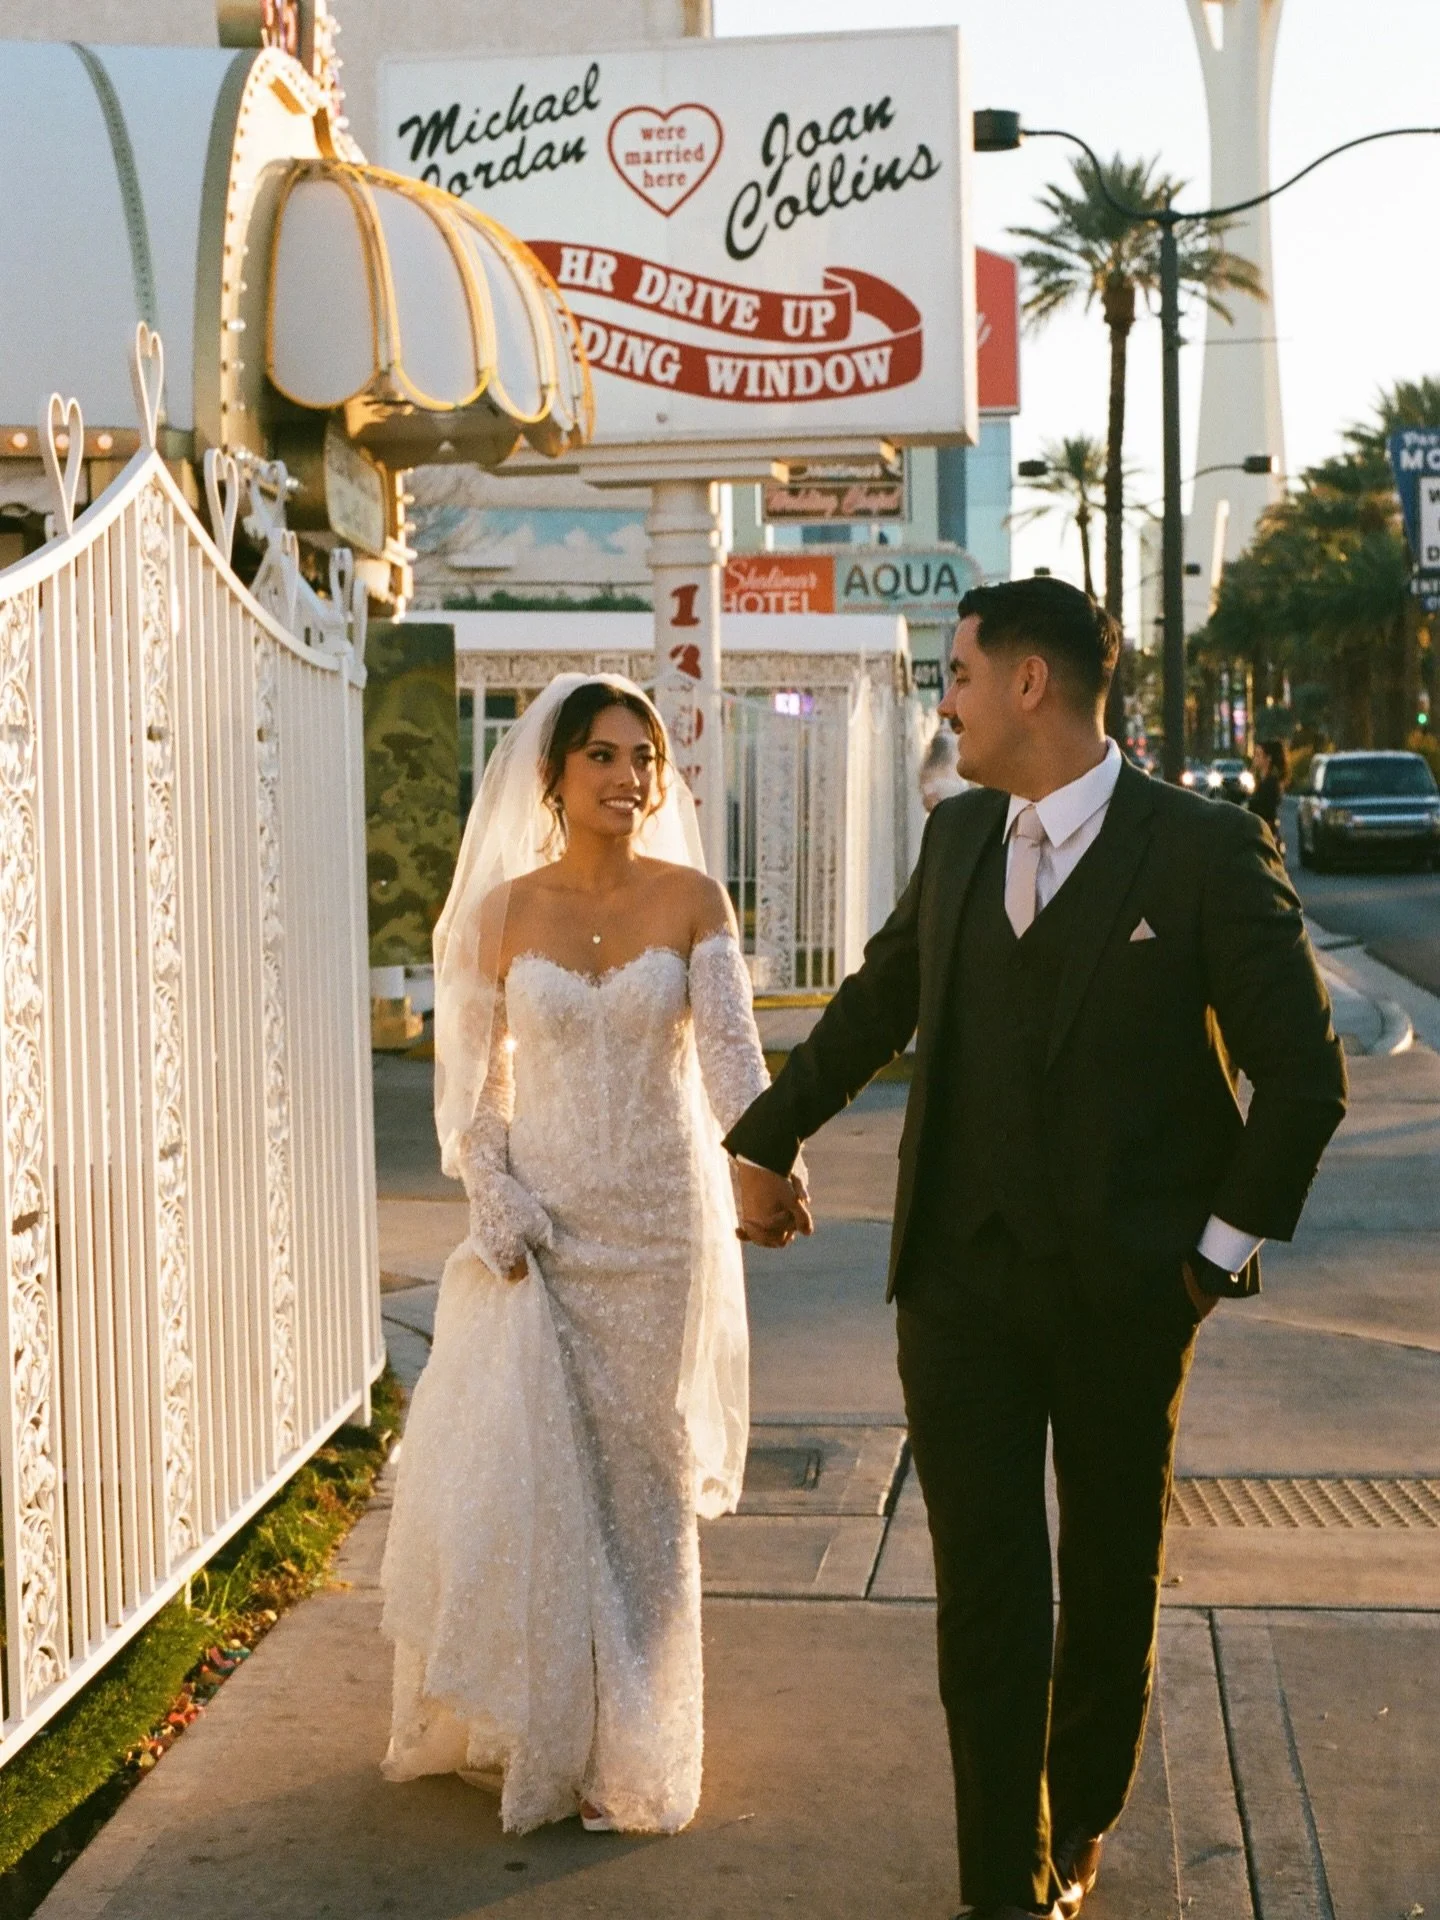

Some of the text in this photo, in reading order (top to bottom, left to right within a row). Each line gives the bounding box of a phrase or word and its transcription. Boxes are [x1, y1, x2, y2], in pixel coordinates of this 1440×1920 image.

[398, 61, 600, 162] Michael
[641, 126, 687, 141] were
[624, 142, 704, 166] married
[761, 95, 896, 198] Joan
[643, 169, 687, 189] here
[724, 143, 943, 261] Collins
[557, 247, 837, 339] HR DRIVE UP
[704, 346, 893, 398] WINDOW
[843, 562, 960, 602] AQUA
